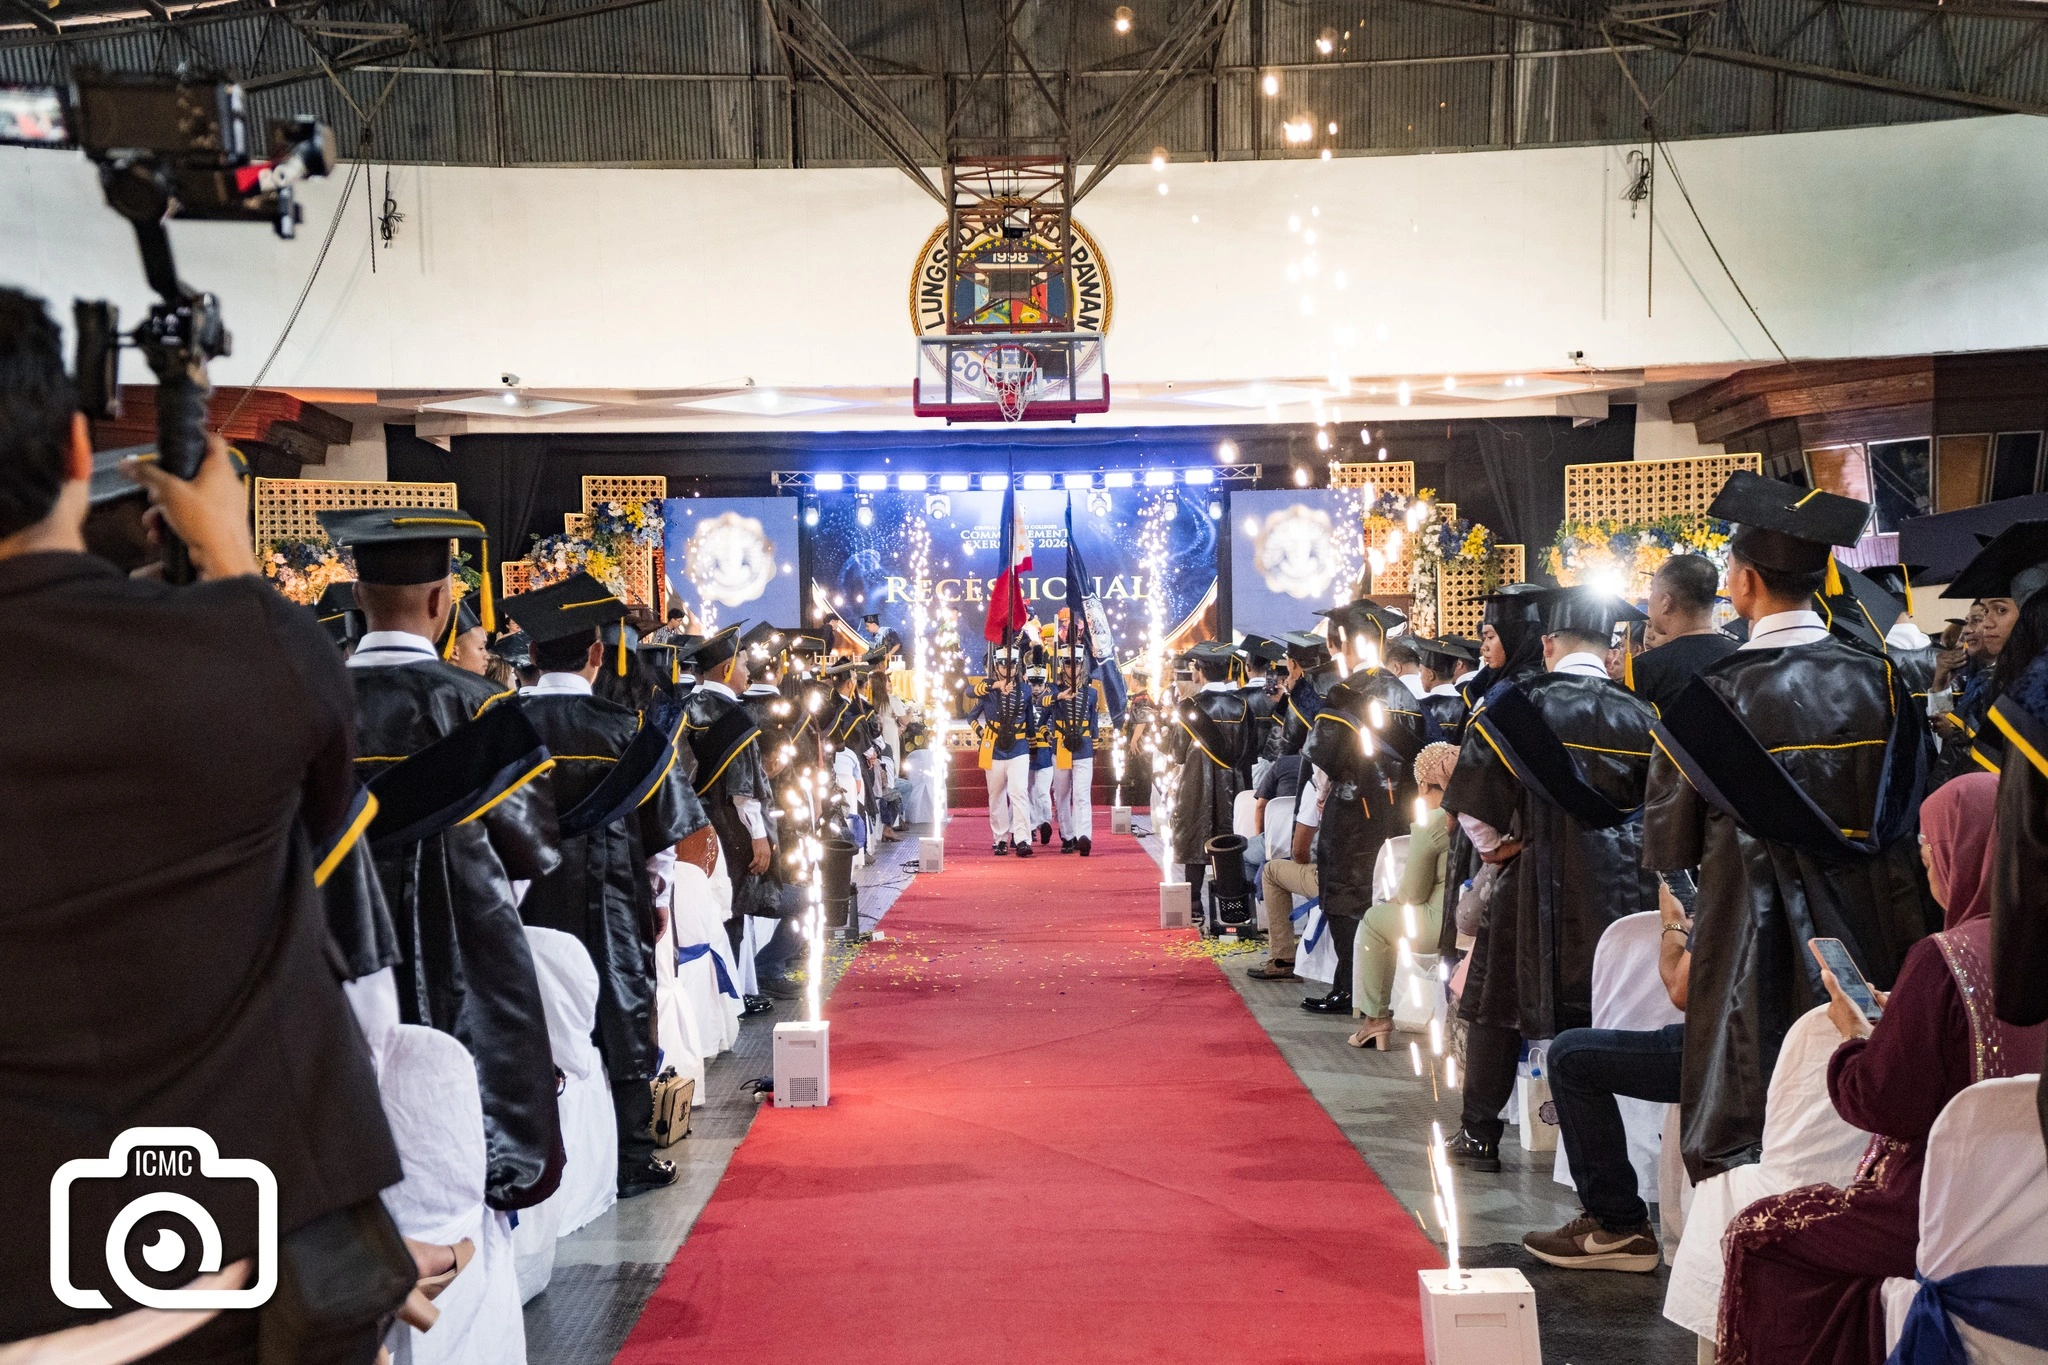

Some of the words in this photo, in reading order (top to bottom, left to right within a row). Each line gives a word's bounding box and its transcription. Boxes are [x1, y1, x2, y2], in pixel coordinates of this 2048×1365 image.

[992, 251, 1029, 263] 1998
[960, 529, 1068, 540] COMMEMENT
[1038, 539, 1068, 548] 2026
